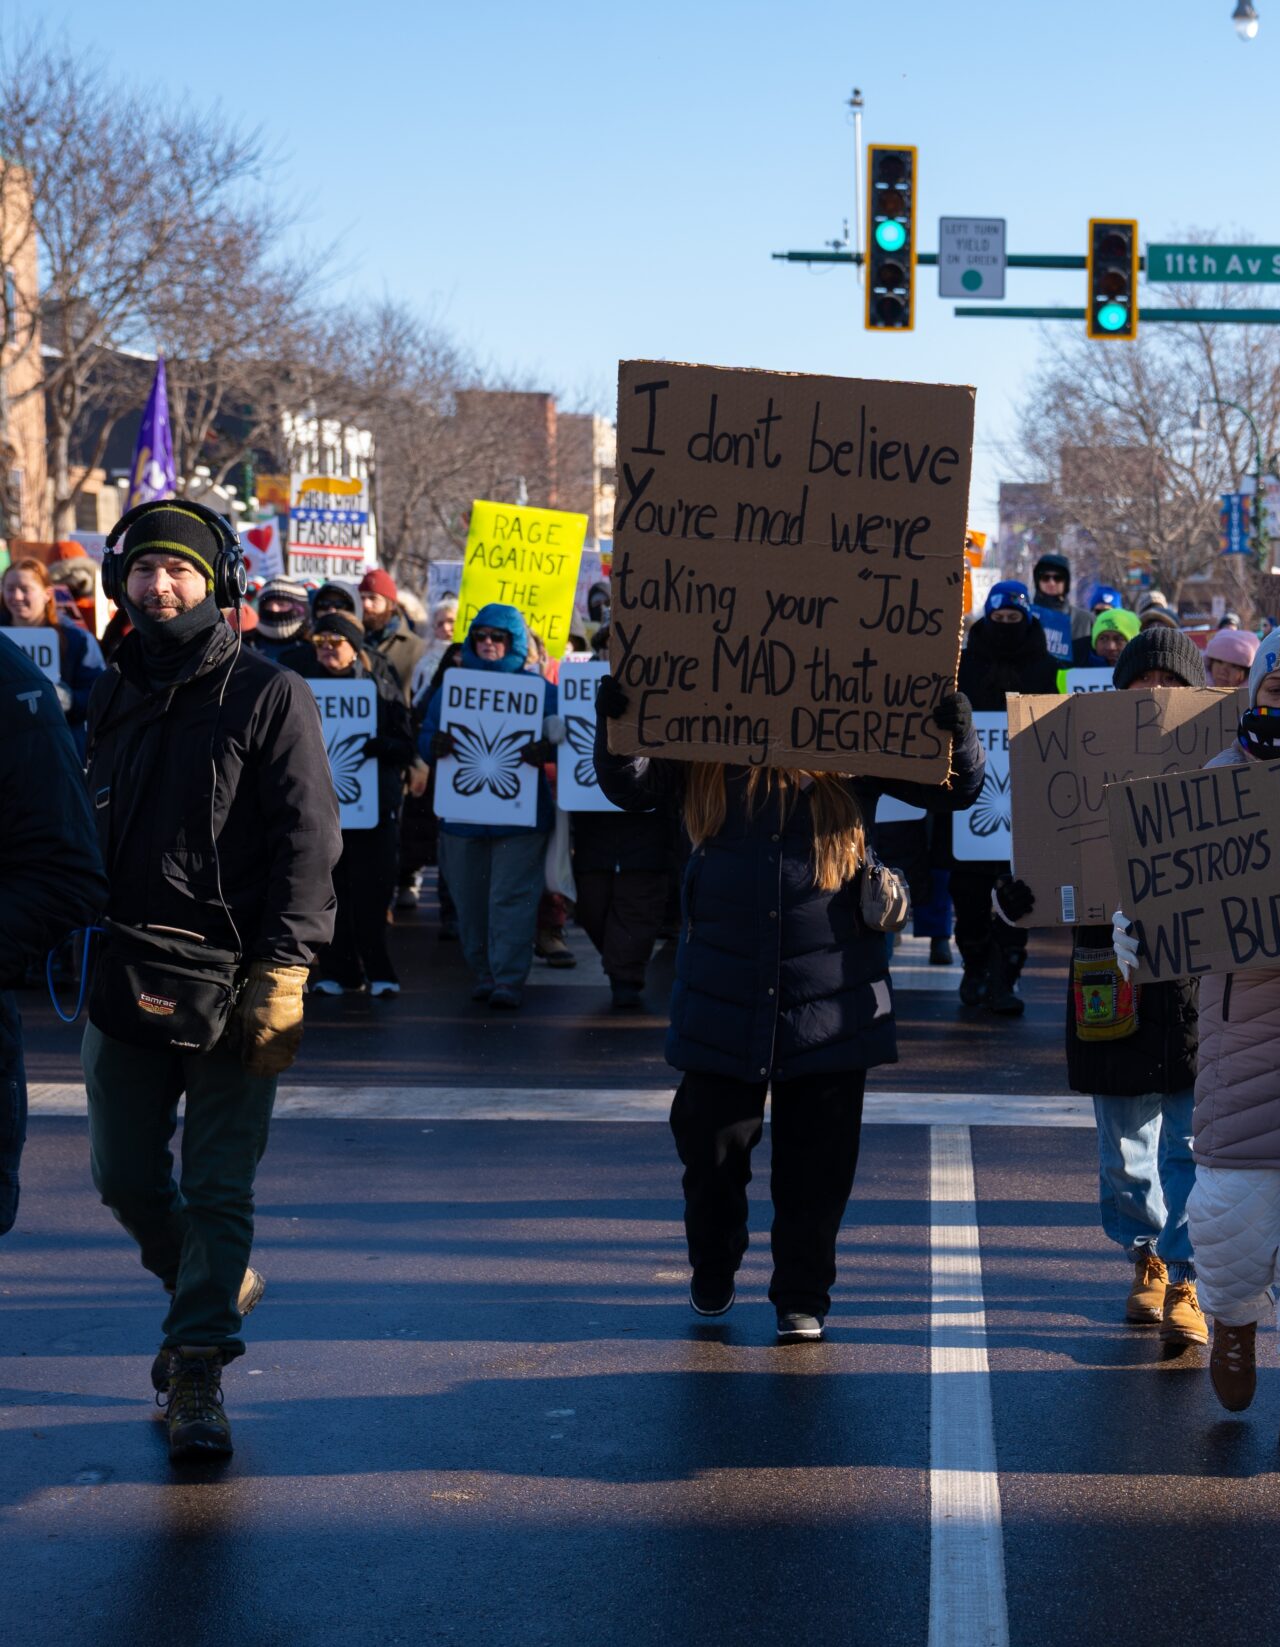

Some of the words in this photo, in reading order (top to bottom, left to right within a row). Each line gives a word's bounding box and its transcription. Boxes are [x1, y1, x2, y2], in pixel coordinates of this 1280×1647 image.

[945, 224, 968, 234] LEFT
[974, 224, 998, 234] TURN
[956, 238, 990, 252] YIELD
[946, 255, 959, 265] ON
[967, 255, 998, 266] GREEN
[1165, 253, 1217, 274] 11th
[1225, 253, 1262, 275] Av
[631, 381, 669, 456] I
[687, 394, 782, 469] don't
[809, 402, 959, 485] believe
[617, 463, 718, 541] You're
[735, 485, 809, 546] mad
[831, 512, 931, 562] we're
[297, 519, 362, 548] FASCISM
[493, 514, 562, 545] RAGE
[295, 556, 328, 574] LOOKS
[333, 557, 361, 576] LIKE
[469, 543, 571, 575] AGAINST
[498, 580, 540, 607] THE
[615, 552, 737, 634] taking
[760, 590, 838, 637] your
[612, 622, 700, 692] You're
[712, 635, 796, 697] MAD
[804, 646, 878, 705] that
[315, 696, 370, 718] END
[448, 685, 538, 715] DEFEND
[638, 690, 770, 766] Earning
[791, 707, 942, 759] DEGREES
[976, 729, 1009, 751] EFE
[1029, 705, 1105, 762] We
[1126, 766, 1260, 848] WHILE
[1128, 829, 1271, 904] DESTROYS
[1134, 908, 1211, 977] WE
[140, 993, 177, 1008] tamrac
